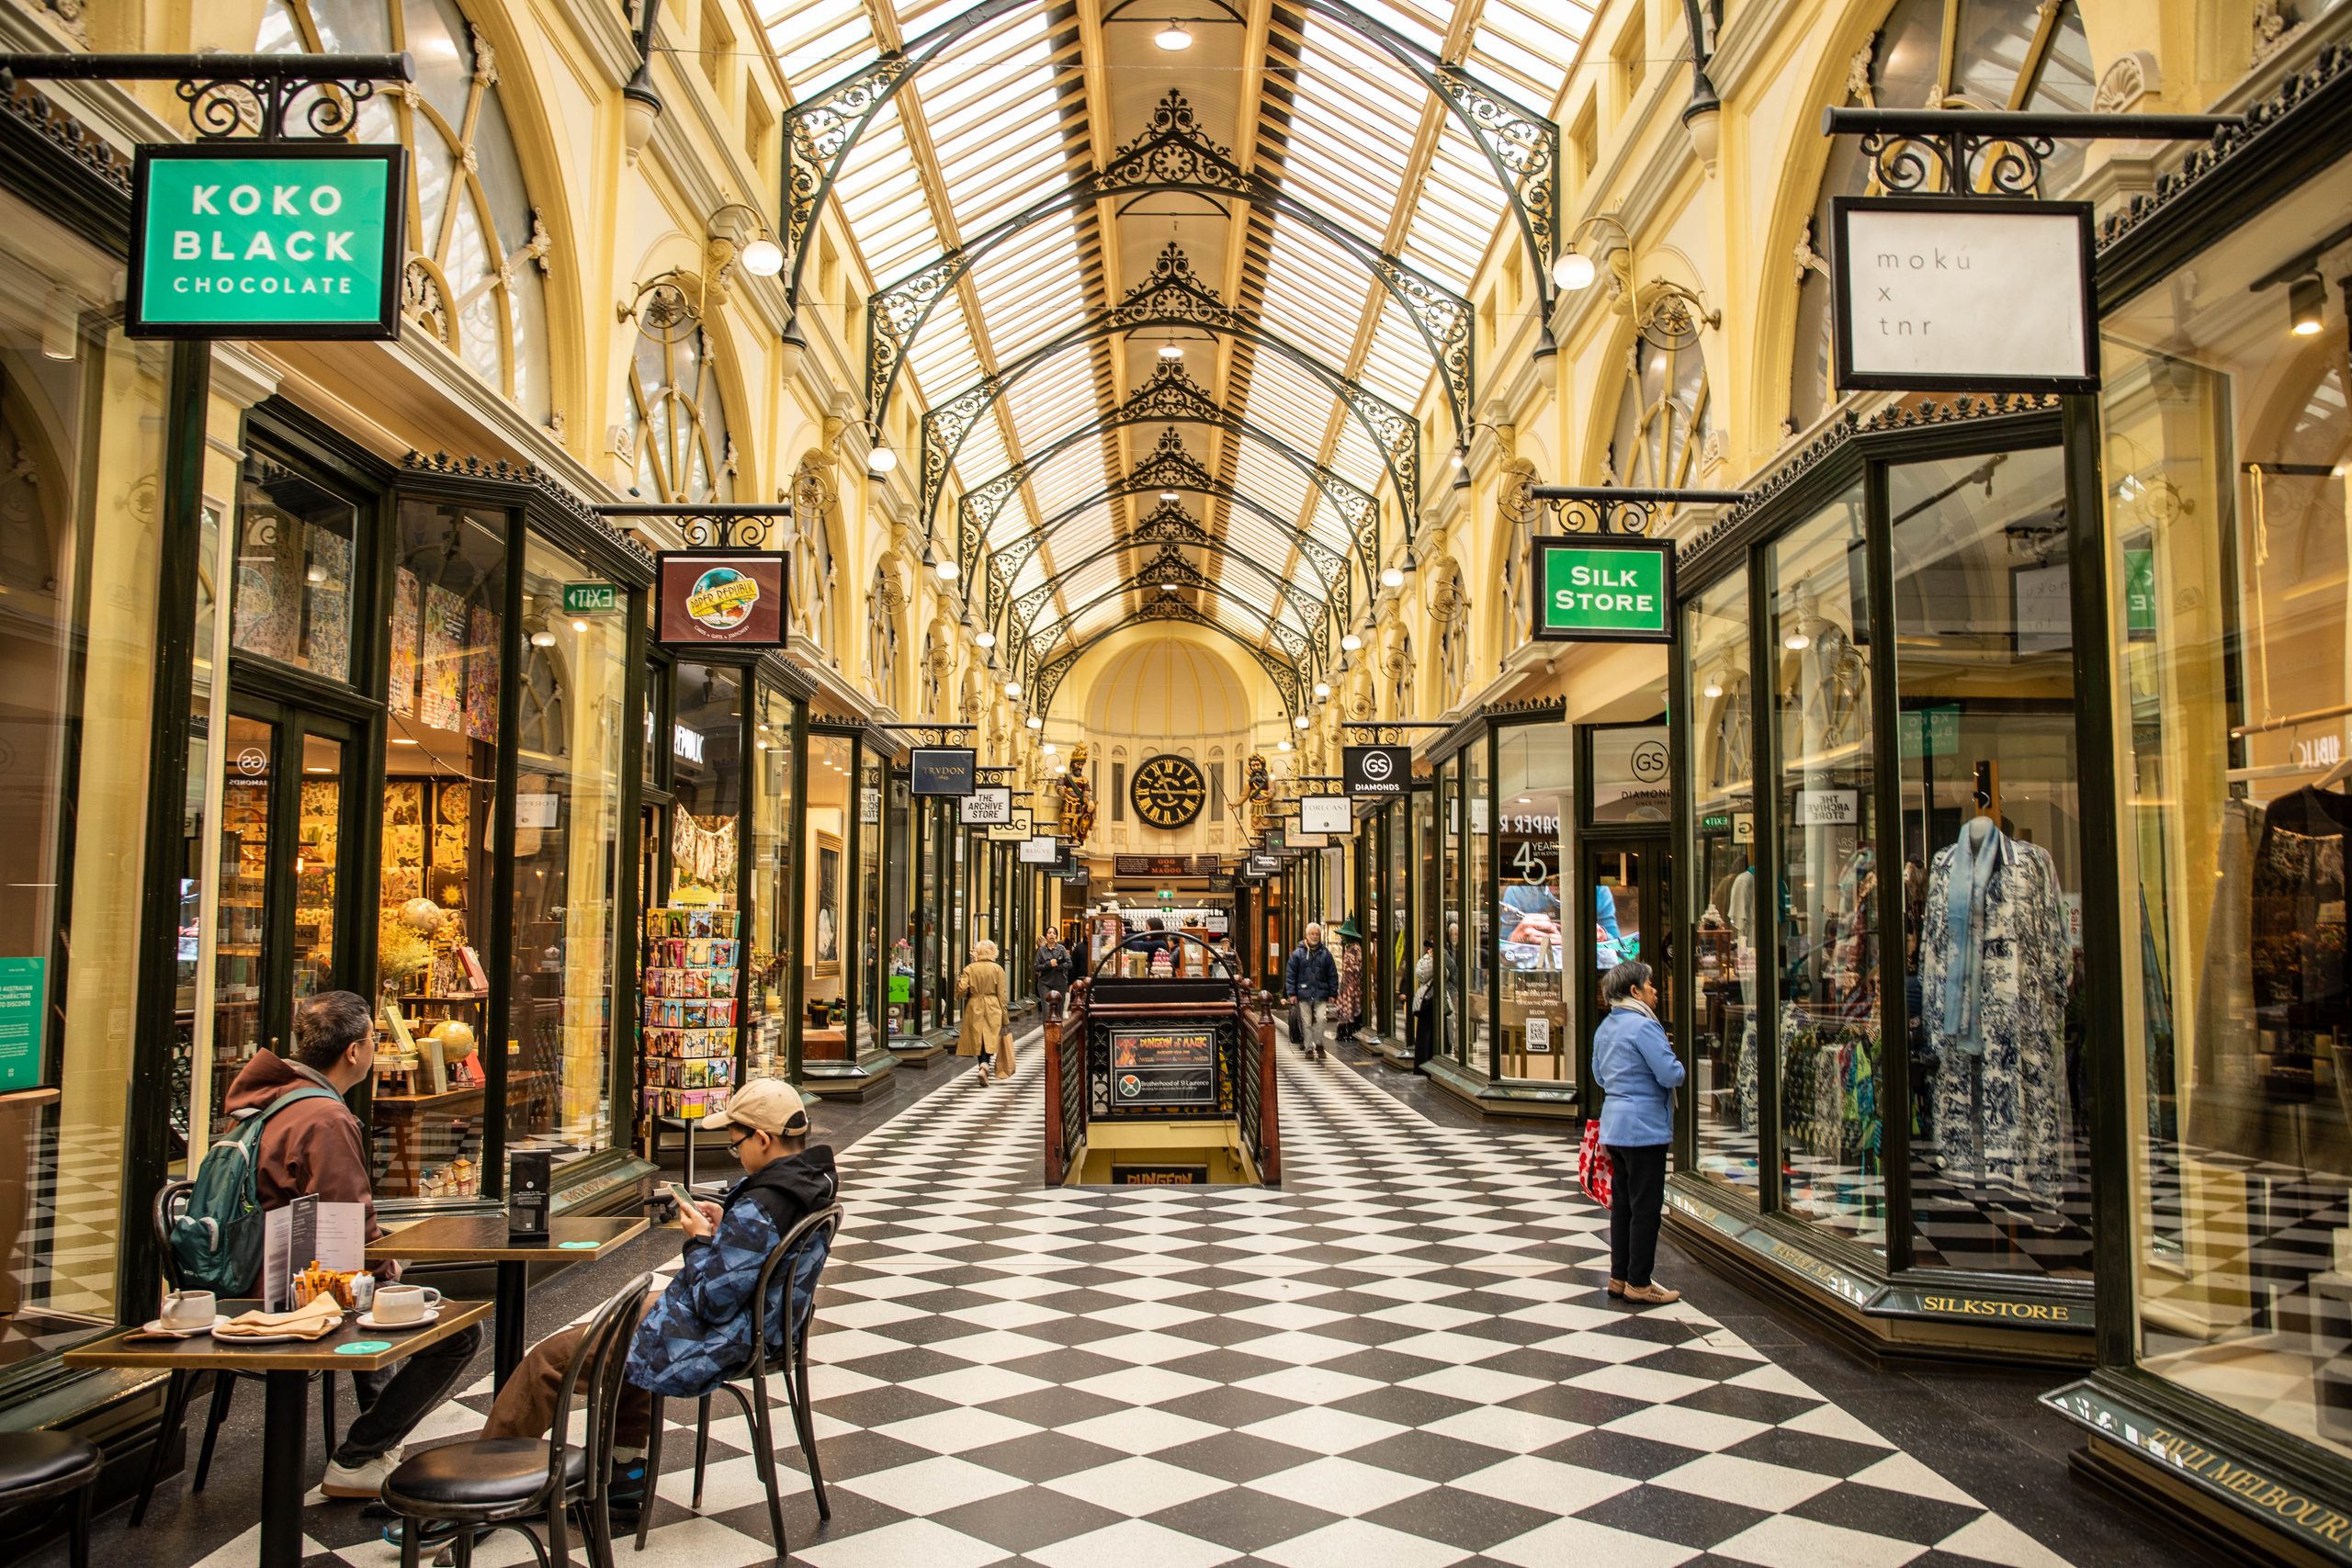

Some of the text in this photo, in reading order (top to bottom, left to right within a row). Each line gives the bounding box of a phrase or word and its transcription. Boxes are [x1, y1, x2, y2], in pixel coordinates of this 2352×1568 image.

[192, 185, 342, 216] KOKO
[173, 231, 355, 261] BLACK
[1878, 247, 1970, 270] moku
[173, 276, 352, 294] CHOCOLATE
[1878, 288, 1892, 301] x
[1879, 318, 1931, 335] tnr
[1571, 566, 1638, 587] SILK
[1555, 590, 1653, 612] STORE
[1365, 759, 1389, 773] GS
[1636, 752, 1664, 772] GS
[1622, 789, 1670, 800] DIAMON
[967, 802, 1003, 810] ARCHIVE
[972, 810, 999, 818] STORE
[1304, 803, 1348, 811] FORECAST
[6, 999, 31, 1008] DISCOVER
[1139, 1037, 1172, 1049] DUNGEON
[1182, 1036, 1207, 1048] MAGIC
[1127, 1172, 1193, 1184] DUNGEON
[1924, 1296, 2069, 1322] SILKSTORE
[2153, 1427, 2218, 1472] TAVLI
